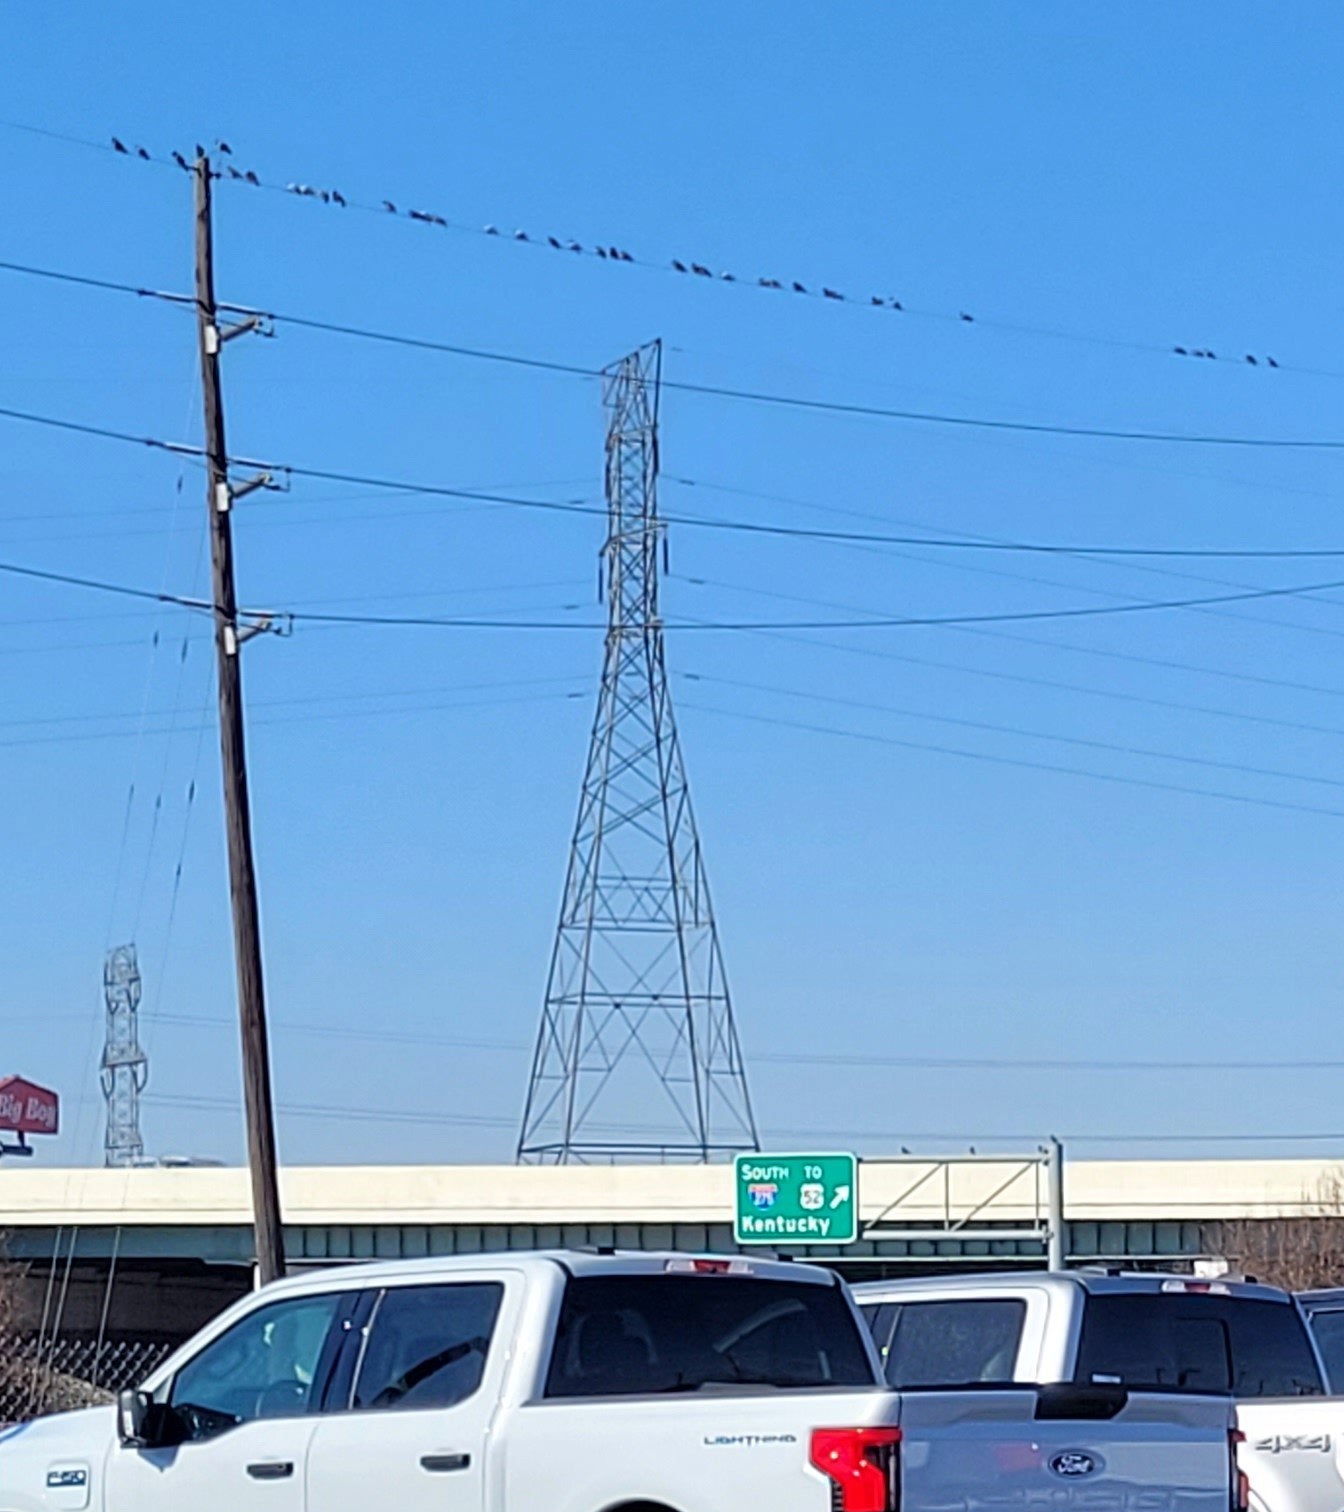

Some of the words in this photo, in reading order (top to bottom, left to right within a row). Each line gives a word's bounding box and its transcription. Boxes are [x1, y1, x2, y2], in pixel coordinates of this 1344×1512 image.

[25, 1096, 55, 1128] Boy
[741, 1164, 789, 1180] SOUTH
[804, 1165, 822, 1179] TO
[803, 1190, 821, 1205] 52
[742, 1215, 830, 1236] Kentucky
[704, 1434, 797, 1446] LIGHTNING
